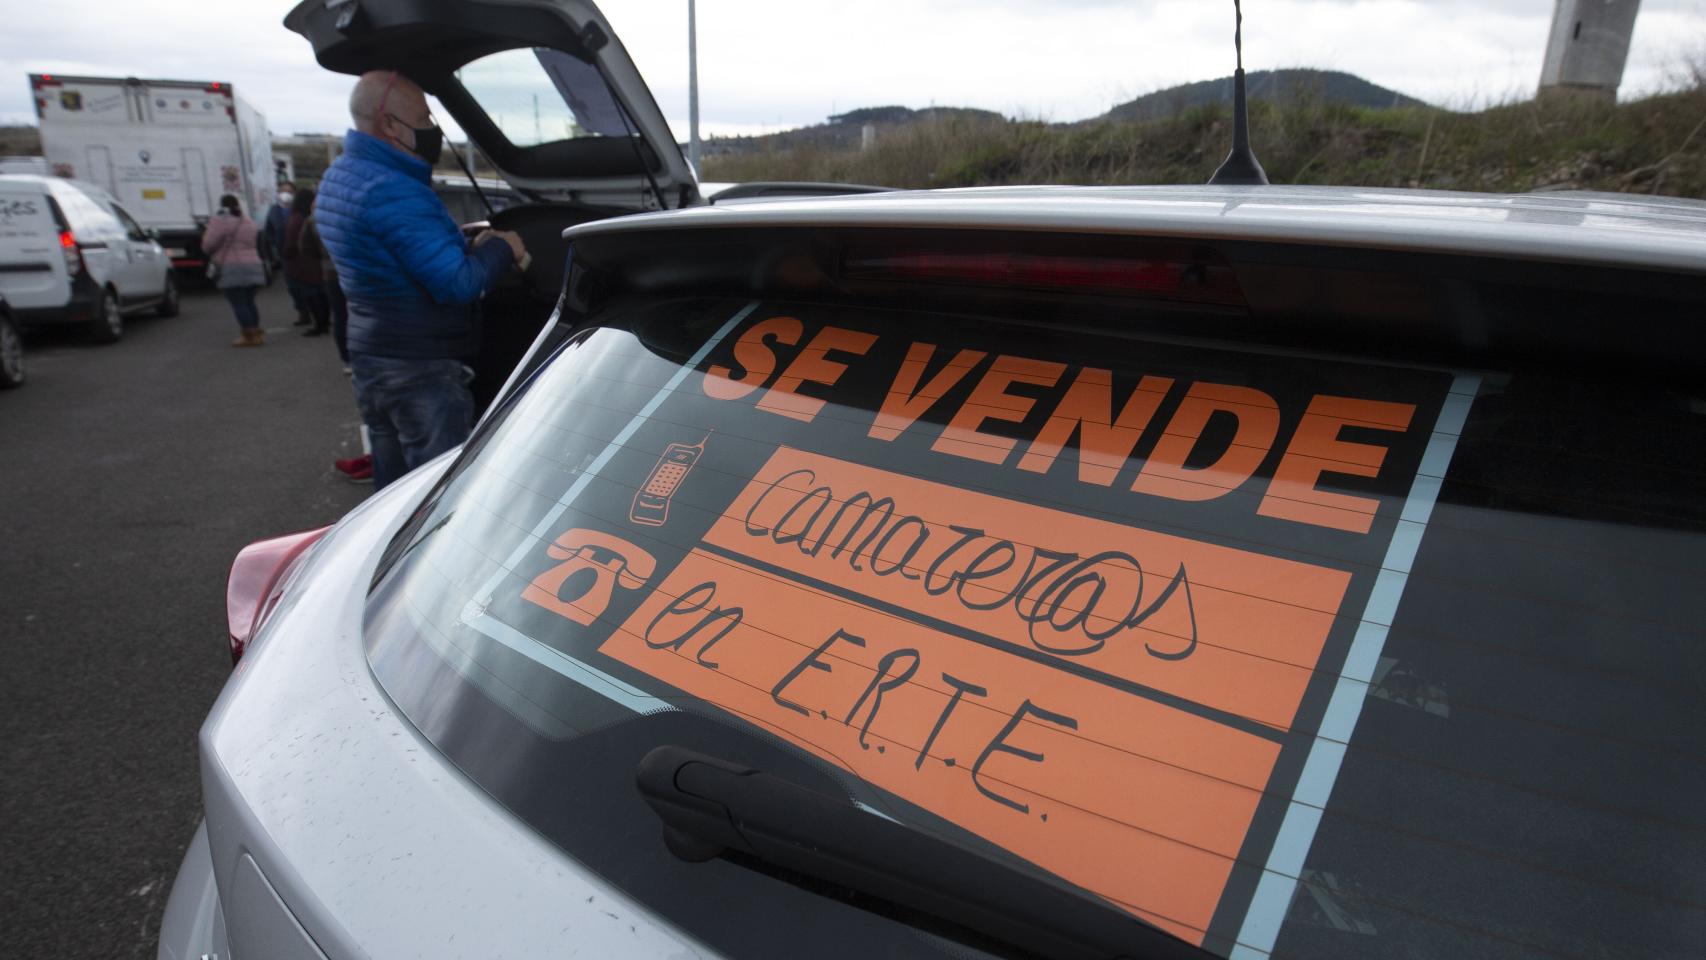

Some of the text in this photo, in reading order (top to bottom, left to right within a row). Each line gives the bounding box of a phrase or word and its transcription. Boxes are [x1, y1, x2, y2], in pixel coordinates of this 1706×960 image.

[702, 316, 1417, 534] SE VENDE
[644, 581, 744, 669] en
